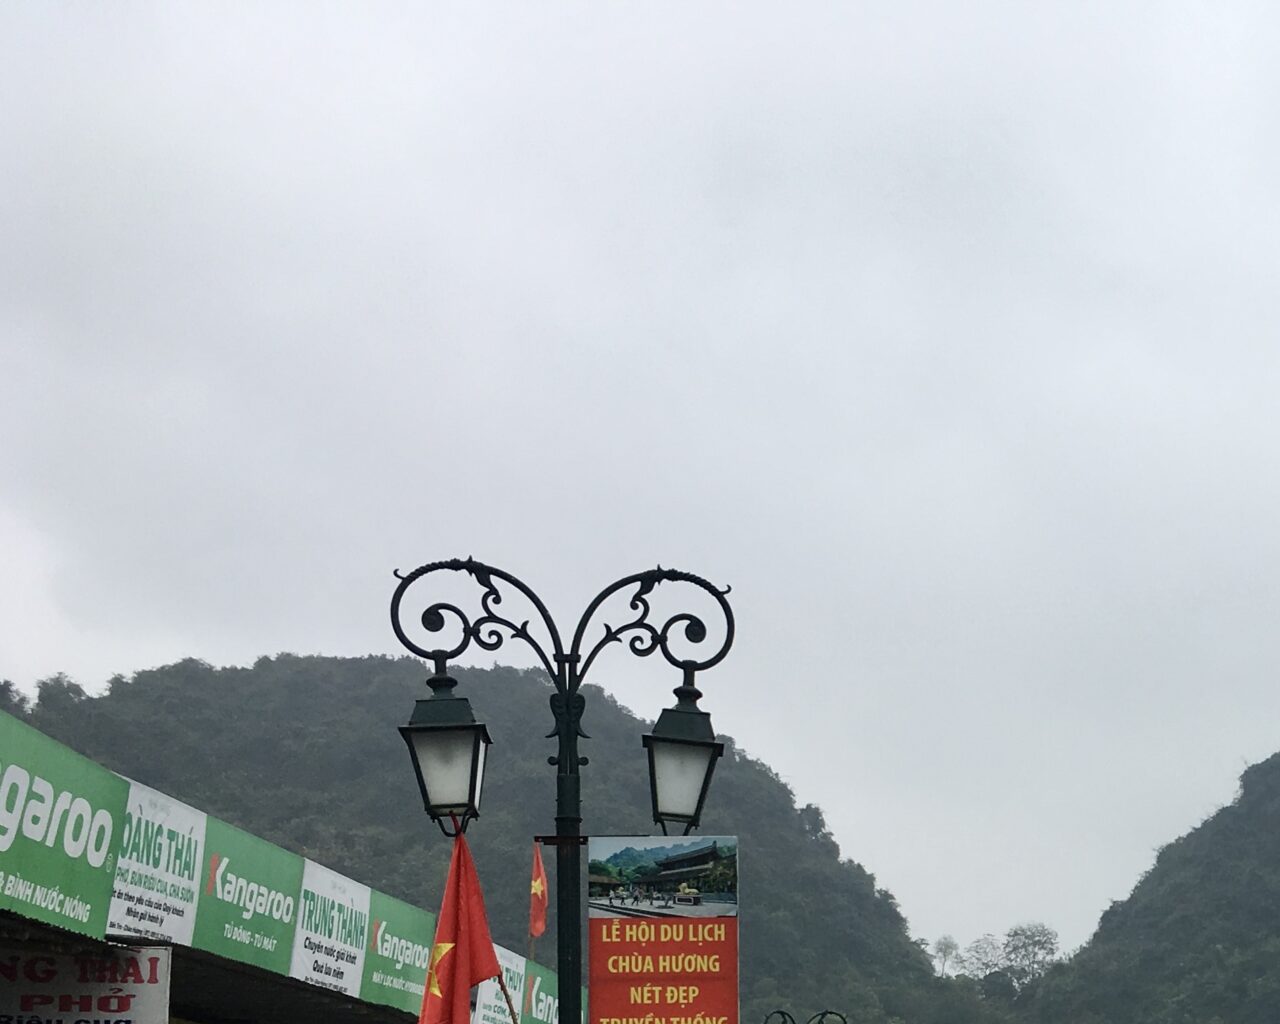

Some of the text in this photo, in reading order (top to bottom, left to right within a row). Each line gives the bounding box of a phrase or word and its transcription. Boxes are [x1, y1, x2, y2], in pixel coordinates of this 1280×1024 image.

[165, 826, 198, 881] THÁI
[4, 872, 91, 922] BÌNH NƯỚC NÓNG
[205, 852, 294, 923] Kangaroo
[302, 889, 366, 950] TRUNG THÀNH
[602, 919, 725, 946] LỄ HỘI DU LỊCH
[304, 937, 324, 954] Chuyên
[369, 919, 429, 970] Kangaroo
[608, 954, 720, 973] CHÙA HƯƠNG
[20, 988, 136, 1013] PHỞ
[631, 985, 699, 1008] NÉT ĐẸP
